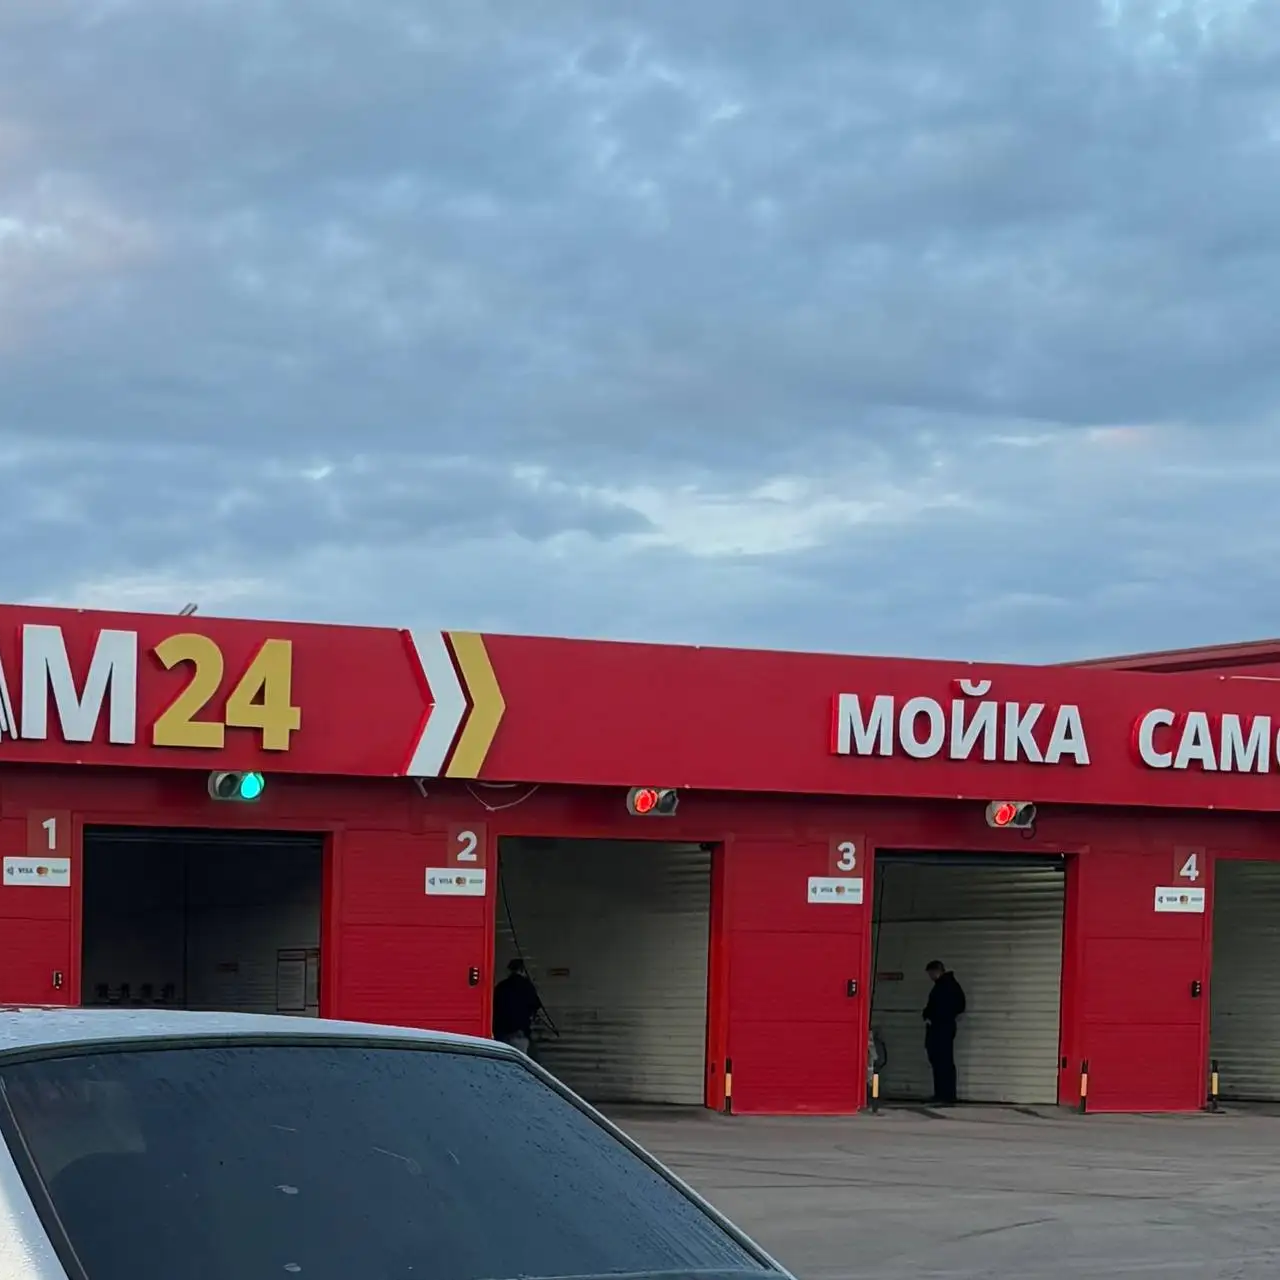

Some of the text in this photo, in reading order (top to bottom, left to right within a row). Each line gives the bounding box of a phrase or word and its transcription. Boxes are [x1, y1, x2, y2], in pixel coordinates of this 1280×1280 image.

[834, 679, 1280, 774] МОЙКА САМ
[42, 817, 56, 850] 1
[456, 830, 478, 861] 2
[836, 841, 856, 872] 3
[1179, 853, 1200, 881] 4
